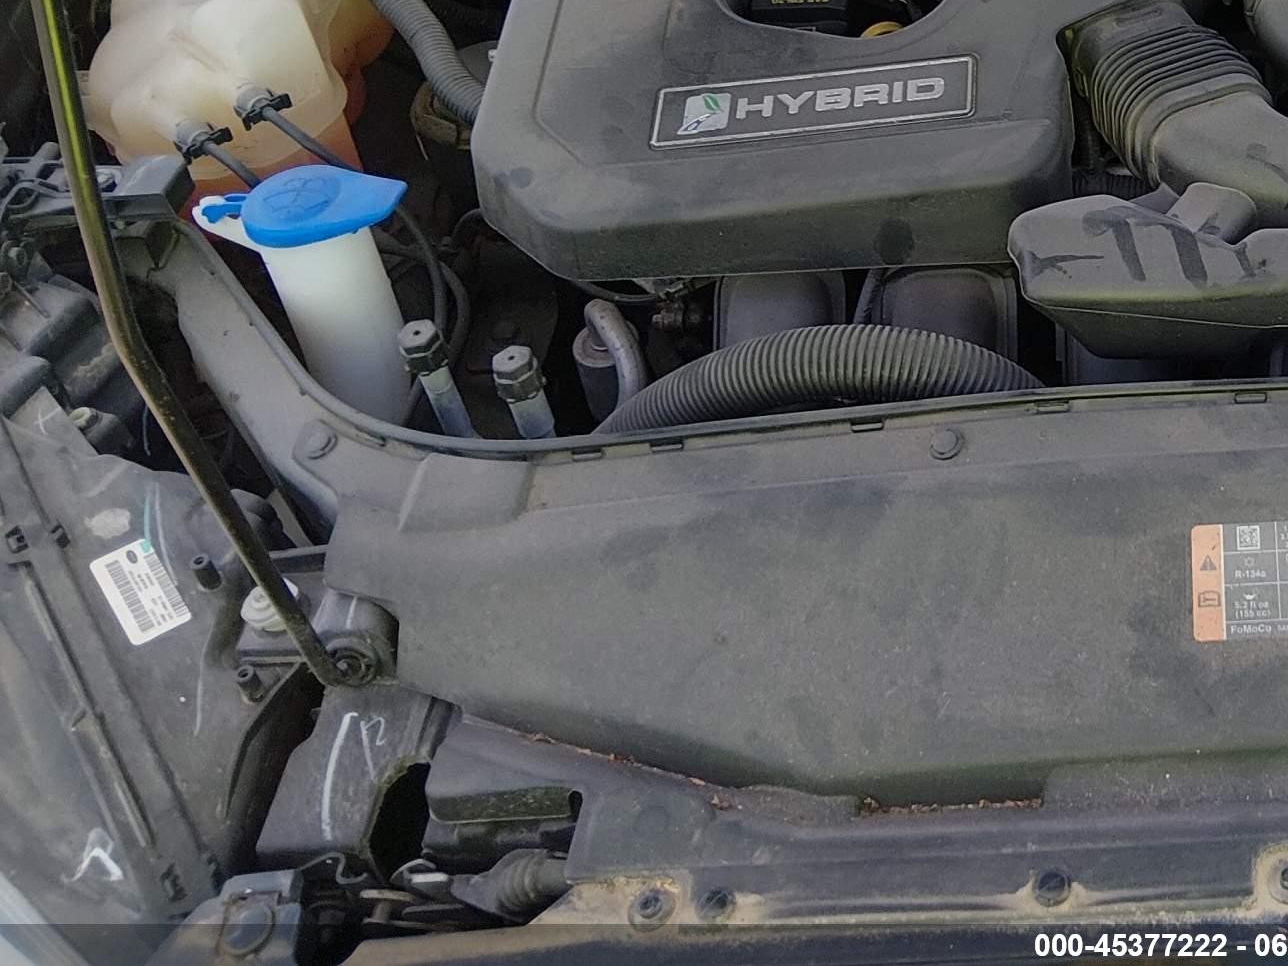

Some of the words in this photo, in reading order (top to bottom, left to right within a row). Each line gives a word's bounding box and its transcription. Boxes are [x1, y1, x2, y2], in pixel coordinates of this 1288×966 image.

[735, 77, 945, 120] HYBRID
[1234, 569, 1267, 579] R-134a
[1231, 624, 1272, 634] FoMoCo
